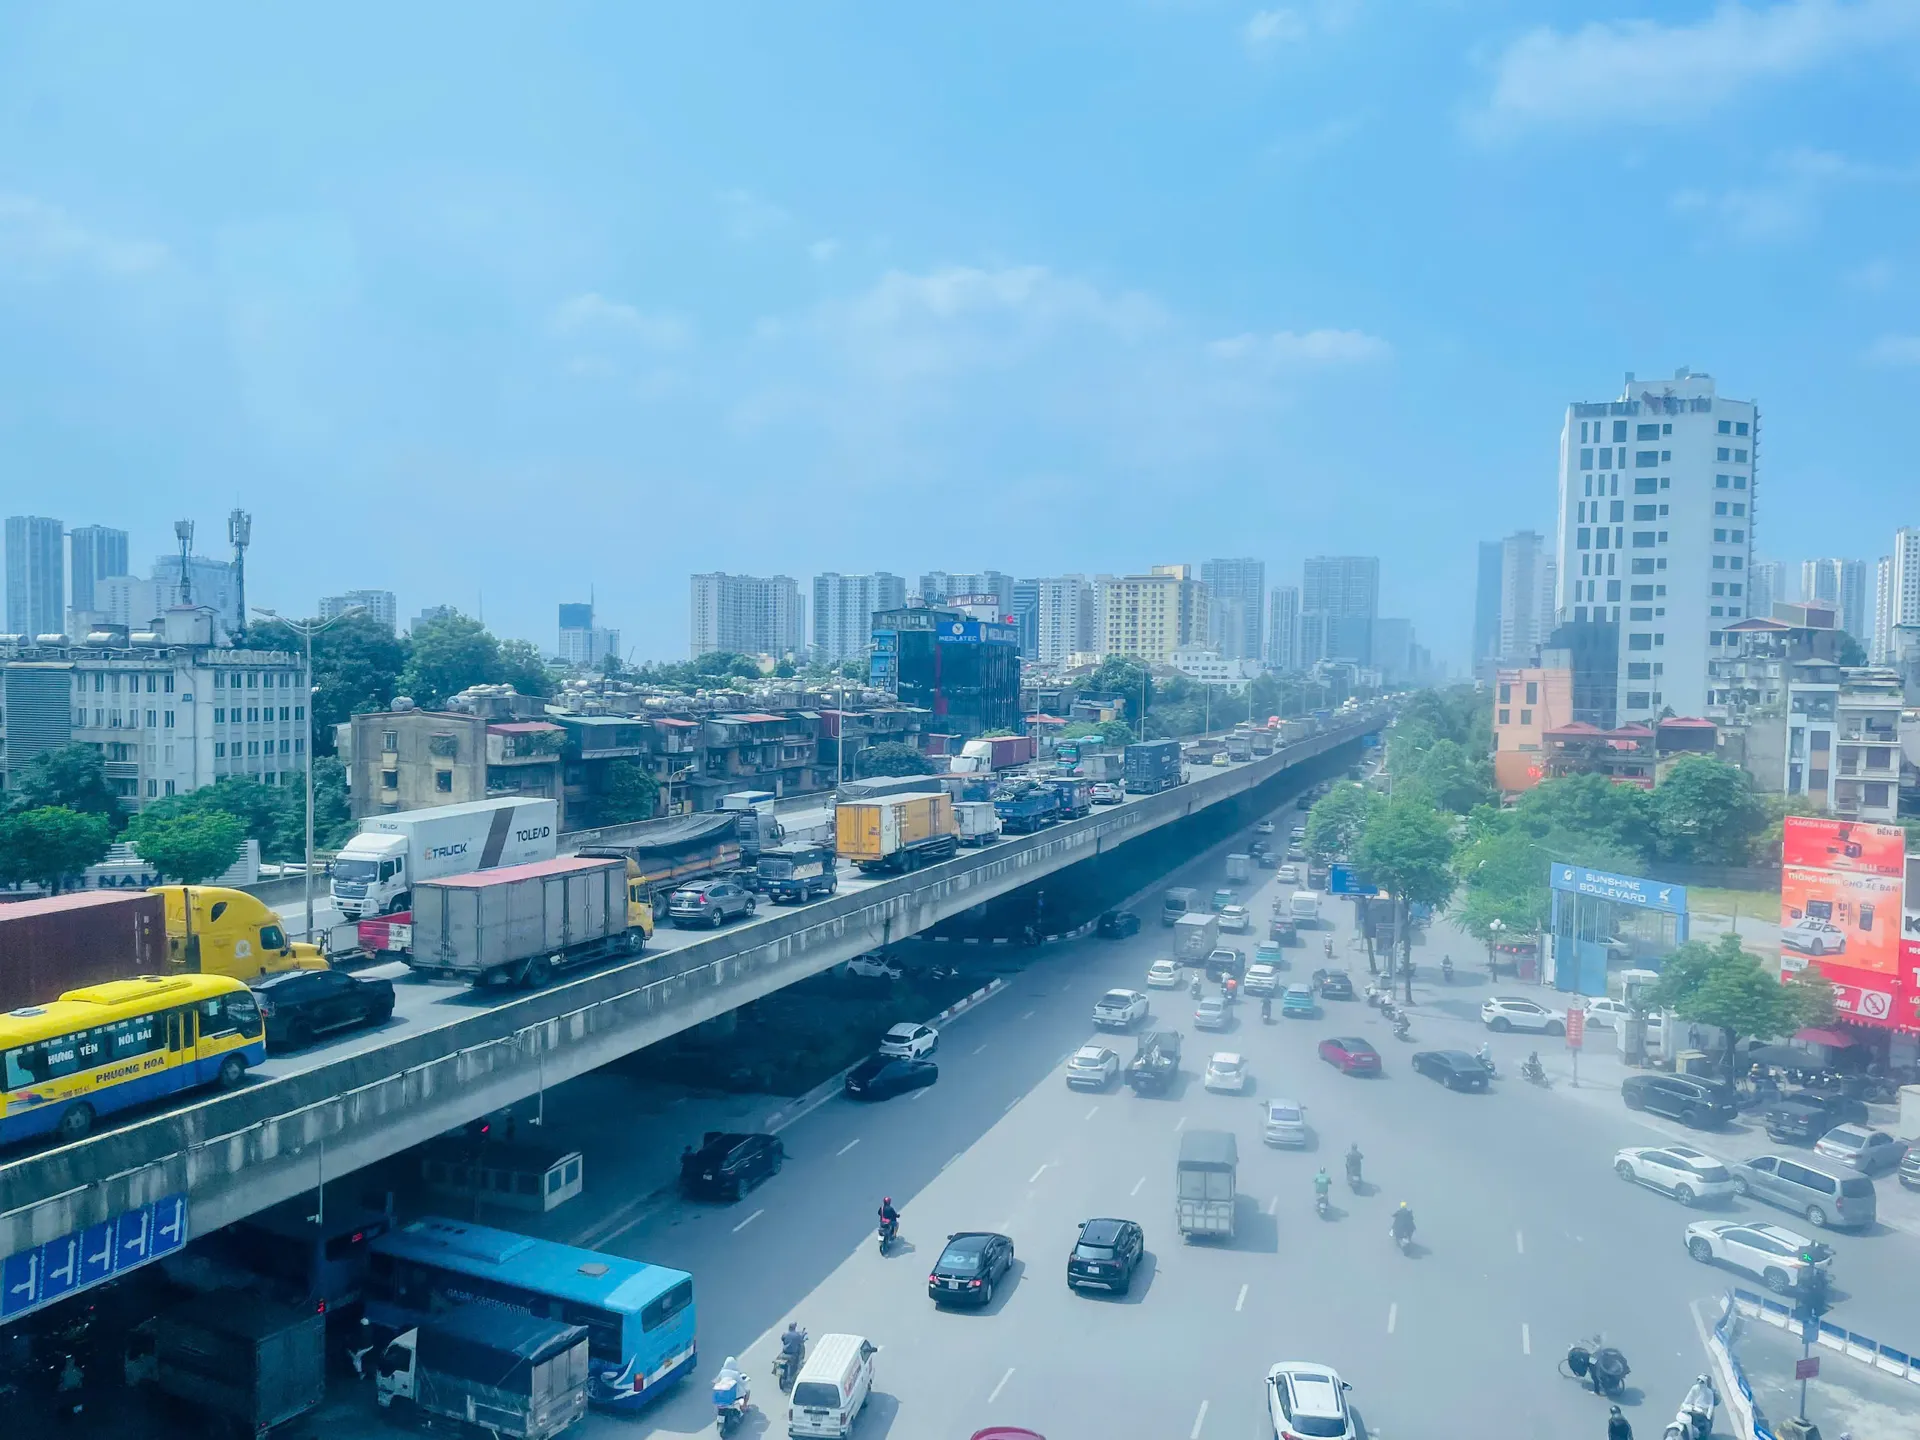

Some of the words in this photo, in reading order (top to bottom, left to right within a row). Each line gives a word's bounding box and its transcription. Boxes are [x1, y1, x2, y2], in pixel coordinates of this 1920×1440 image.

[516, 826, 550, 843] TOLEAD
[425, 843, 467, 860] ETRUCK
[1585, 873, 1641, 891] SUNSHINE
[1843, 880, 1863, 889] CHO
[1580, 882, 1647, 903] BOULEVARD
[80, 1043, 98, 1056] YÊN
